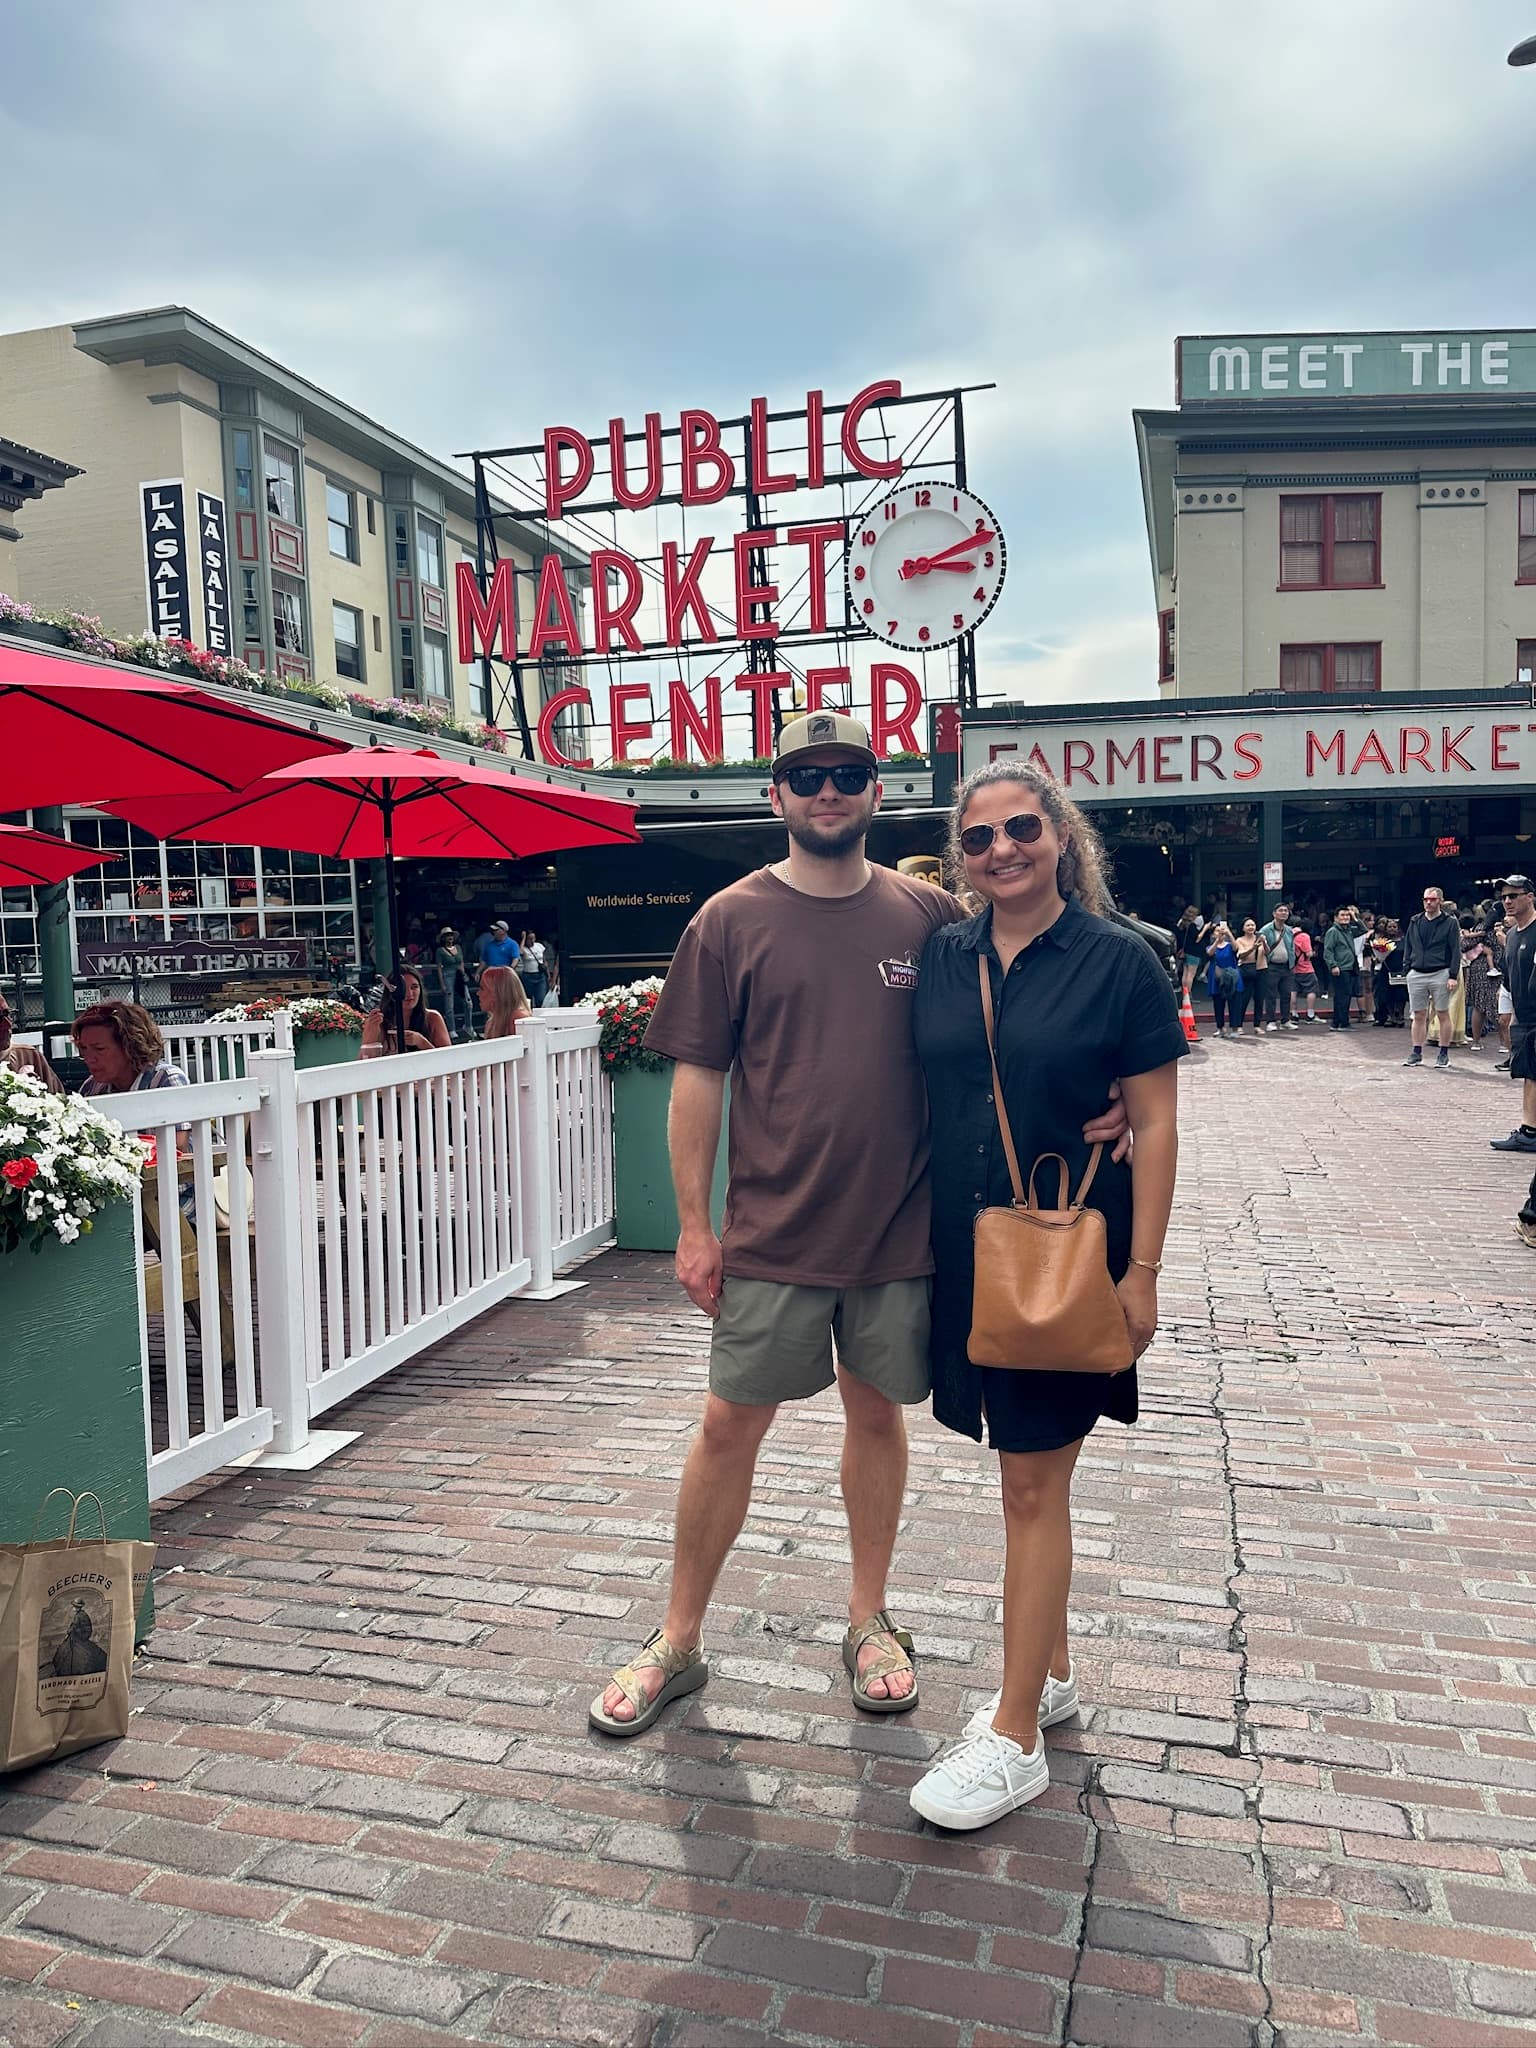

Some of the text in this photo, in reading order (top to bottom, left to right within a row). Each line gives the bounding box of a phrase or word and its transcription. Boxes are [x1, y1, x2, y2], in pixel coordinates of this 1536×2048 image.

[1208, 341, 1510, 392] MEET THE
[544, 380, 903, 520] PUBLIC
[915, 490, 931, 507] 12
[884, 502, 897, 520] 11
[975, 518, 986, 533] 2
[861, 530, 877, 547] 10
[150, 492, 182, 641] LA SALLE
[984, 551, 994, 568] 3
[202, 498, 226, 650] LA SALLE
[854, 565, 866, 581] 9
[455, 523, 847, 664] MARKET
[973, 586, 986, 603] 4
[863, 598, 875, 615] 8
[887, 620, 898, 636] 7
[953, 614, 964, 629] 5
[918, 626, 930, 642] 6
[1305, 723, 1536, 778] MARKE
[586, 894, 644, 908] Worldwide
[97, 951, 293, 976] MARKET THEATER
[47, 1573, 113, 1597] BEECHER'S
